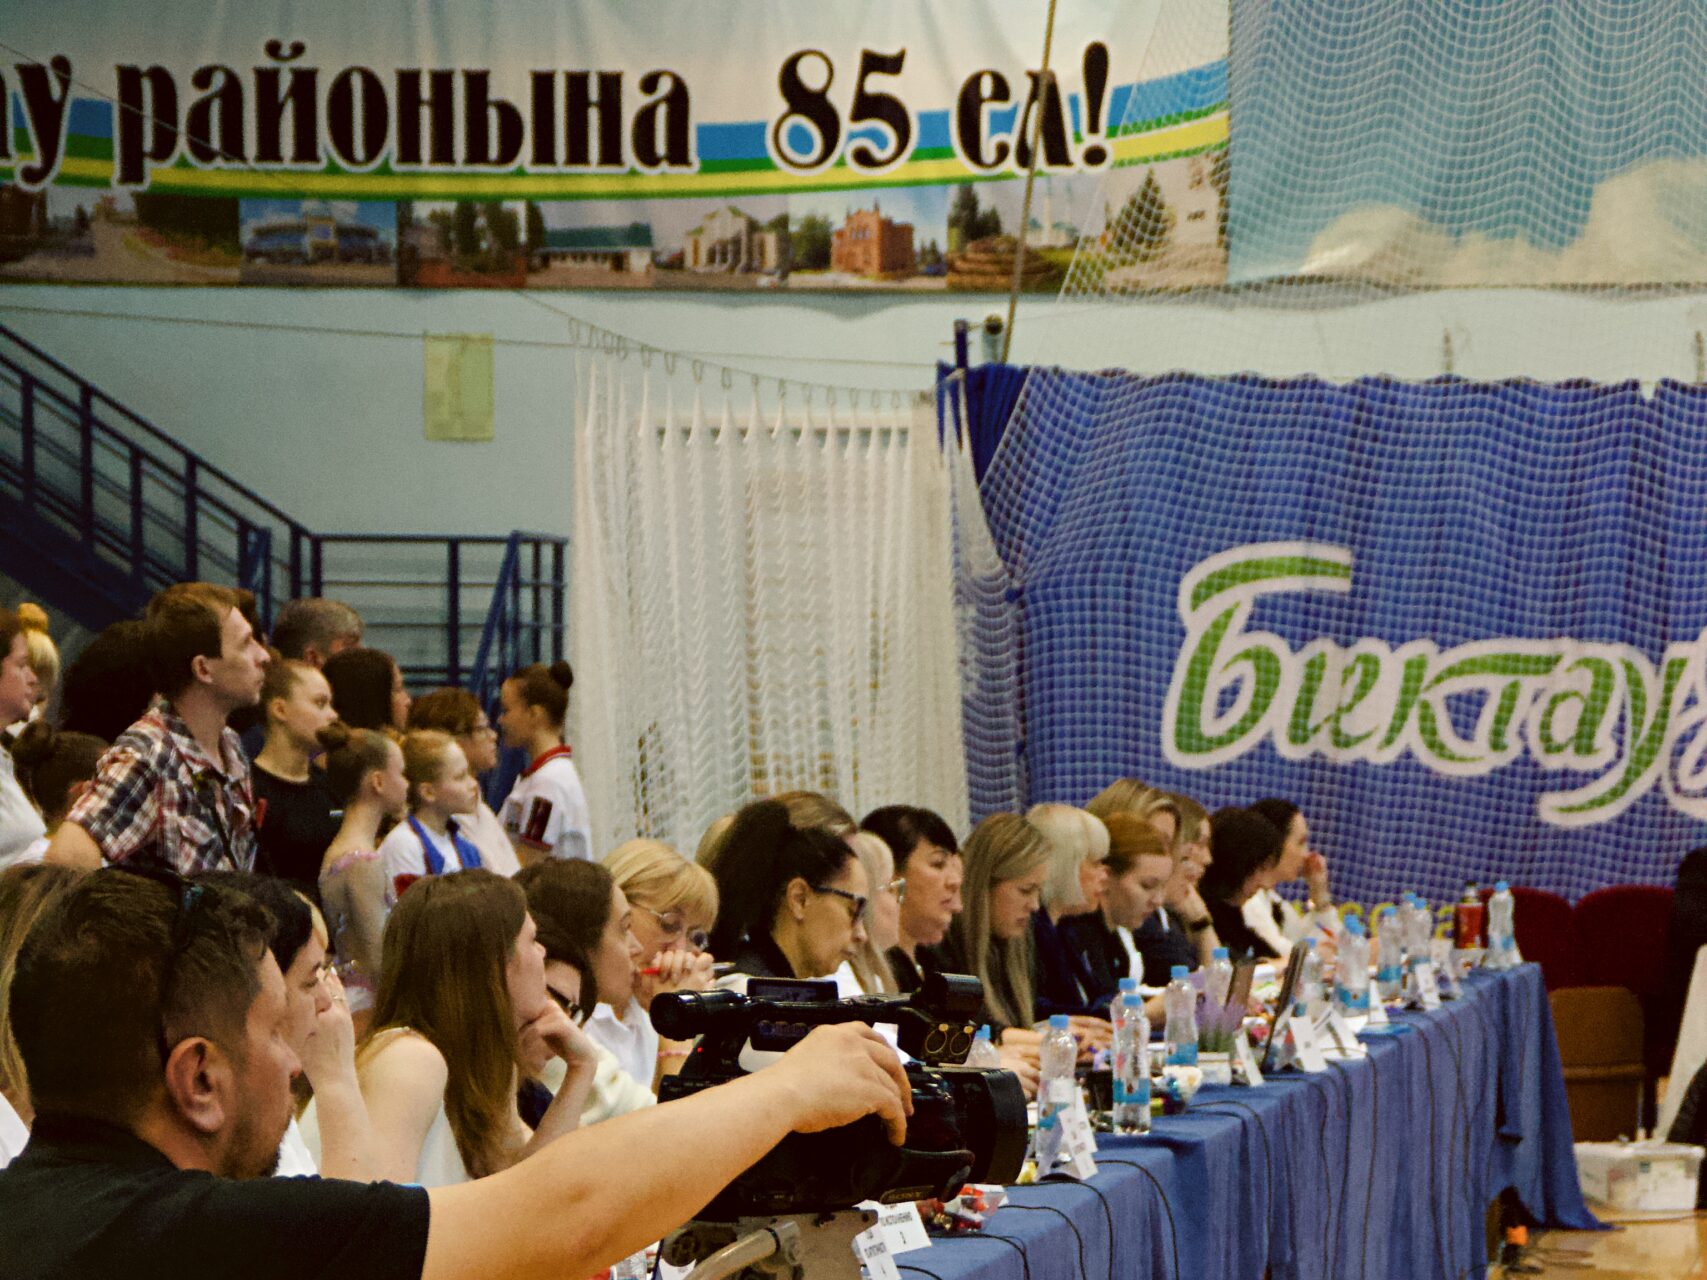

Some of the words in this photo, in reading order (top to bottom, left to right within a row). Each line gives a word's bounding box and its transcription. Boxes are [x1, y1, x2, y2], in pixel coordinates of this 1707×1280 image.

[114, 39, 692, 185] районына
[773, 47, 912, 170] 85
[957, 42, 1109, 170] ел!
